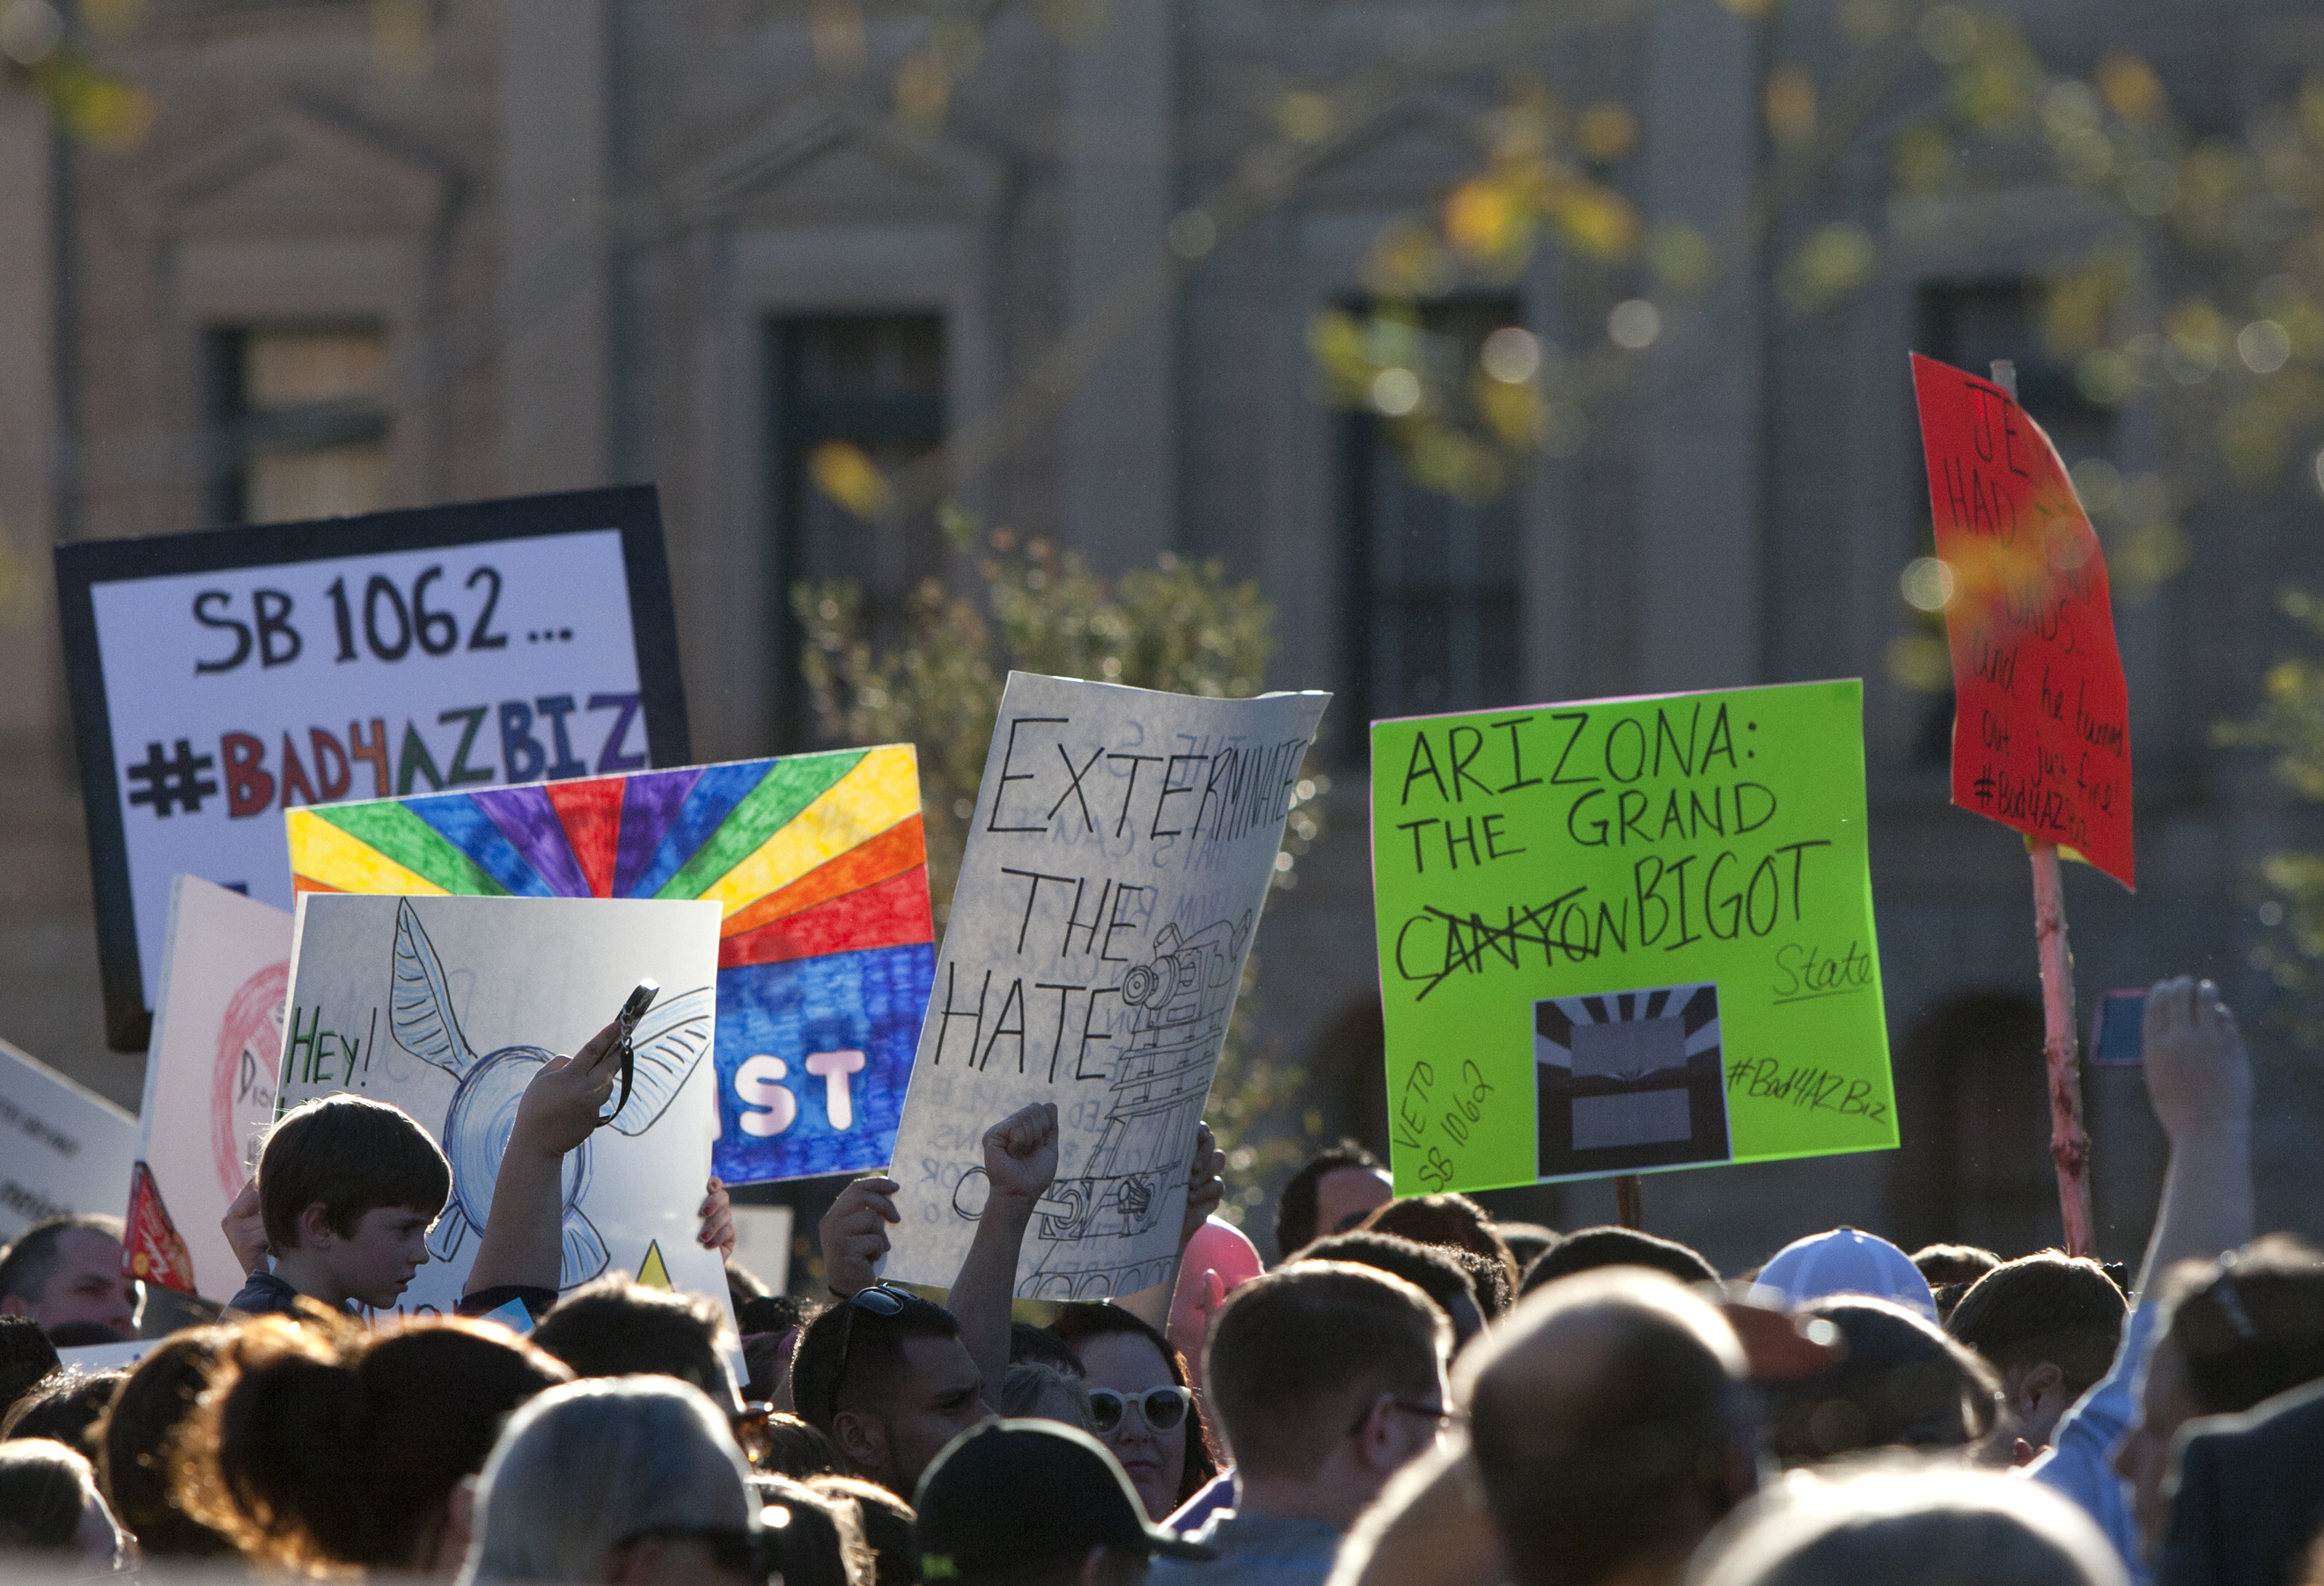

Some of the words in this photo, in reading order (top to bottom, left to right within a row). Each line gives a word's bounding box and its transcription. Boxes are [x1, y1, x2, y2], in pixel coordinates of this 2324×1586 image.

[1943, 456, 2017, 549] HAD
[191, 588, 303, 677] SB
[2041, 665, 2064, 721] he
[126, 692, 649, 819] #BAD4AZBIZ
[987, 716, 1308, 842] EXTERMINATE
[1401, 701, 1757, 805] ARIZONA:
[1396, 813, 1527, 874] THE
[1567, 782, 1777, 848] GRAND
[1001, 866, 1145, 963] THE
[1634, 839, 1833, 951] BIGOT
[1772, 940, 1874, 996] State
[284, 1005, 378, 1088] HEY!
[934, 960, 1122, 1084] HATE
[1393, 1060, 1435, 1149] VETO
[1418, 1146, 1454, 1193] SB
[1440, 1059, 1496, 1148] 1062
